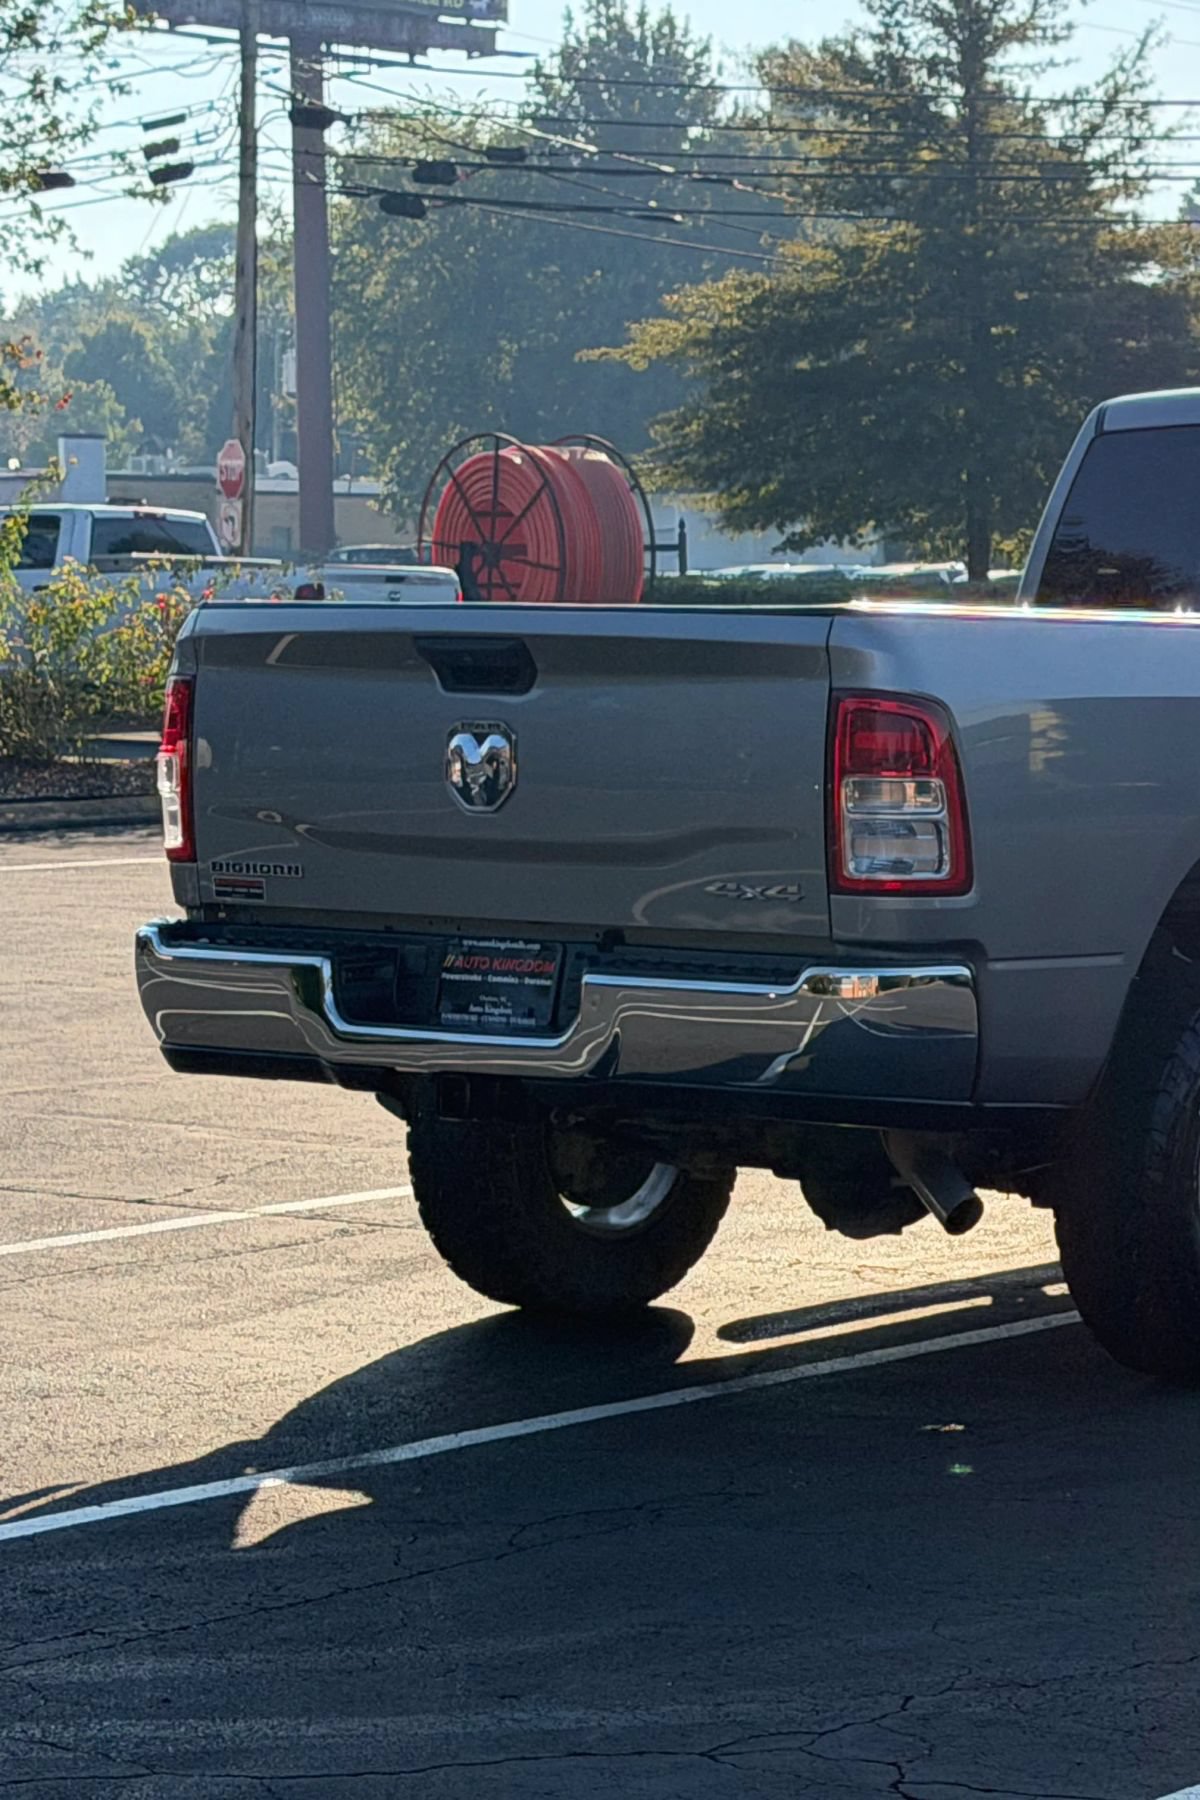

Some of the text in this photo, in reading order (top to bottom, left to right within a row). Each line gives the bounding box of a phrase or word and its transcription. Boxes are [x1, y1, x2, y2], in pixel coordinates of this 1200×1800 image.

[220, 460, 244, 481] STOP
[454, 955, 555, 972] AUTO KINGDOM
